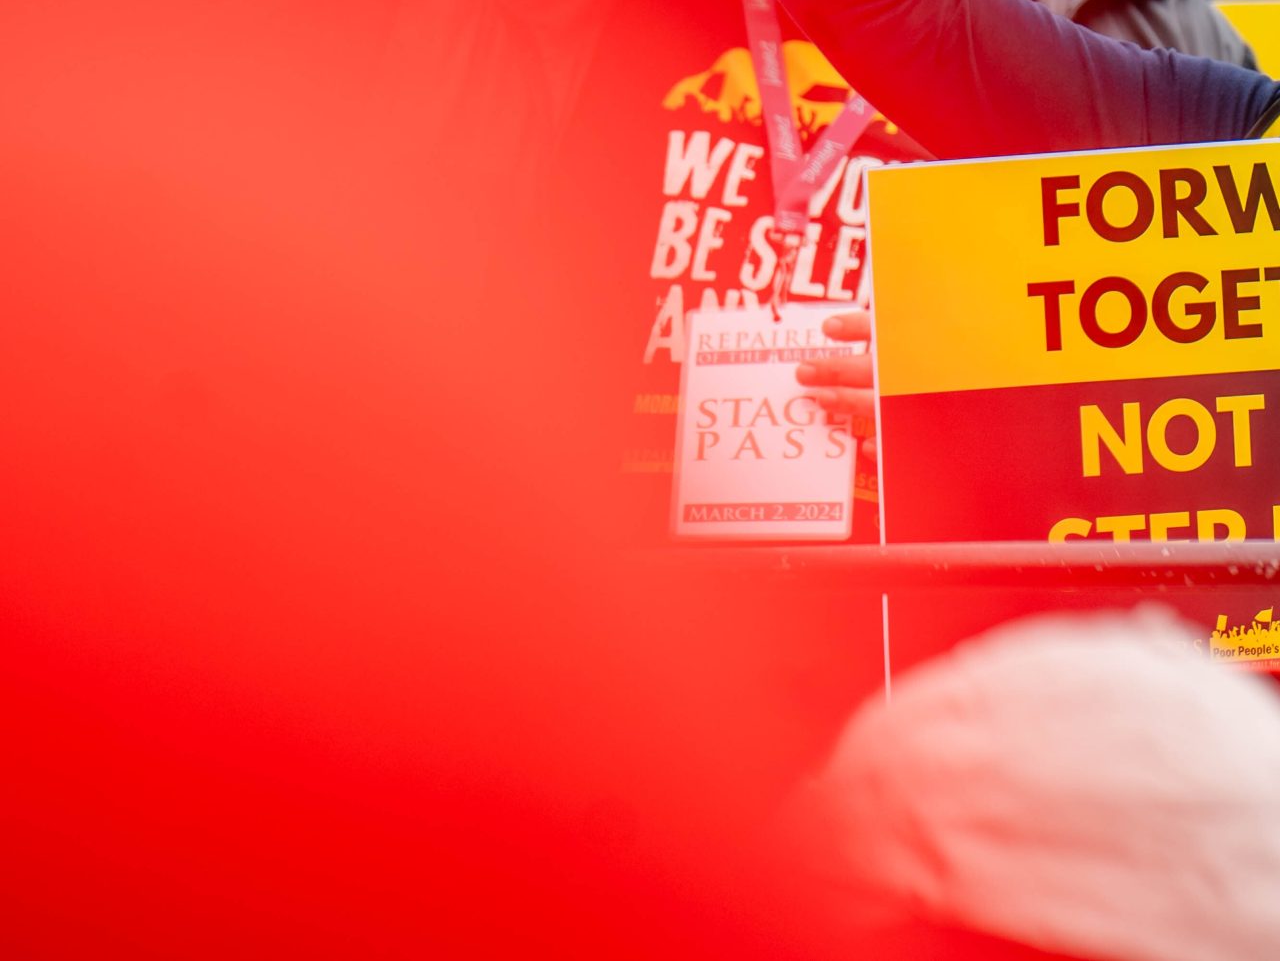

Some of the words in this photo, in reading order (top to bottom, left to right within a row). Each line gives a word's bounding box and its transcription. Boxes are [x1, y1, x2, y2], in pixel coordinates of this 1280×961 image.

[663, 130, 764, 207] WE
[650, 200, 733, 281] BE
[698, 329, 838, 350] REPAIRE
[694, 428, 847, 461] PASS
[1080, 393, 1267, 478] NOT
[688, 506, 765, 522] MARCH
[796, 503, 843, 521] 2024
[1213, 647, 1235, 658] Poor
[1238, 643, 1280, 657] People's
